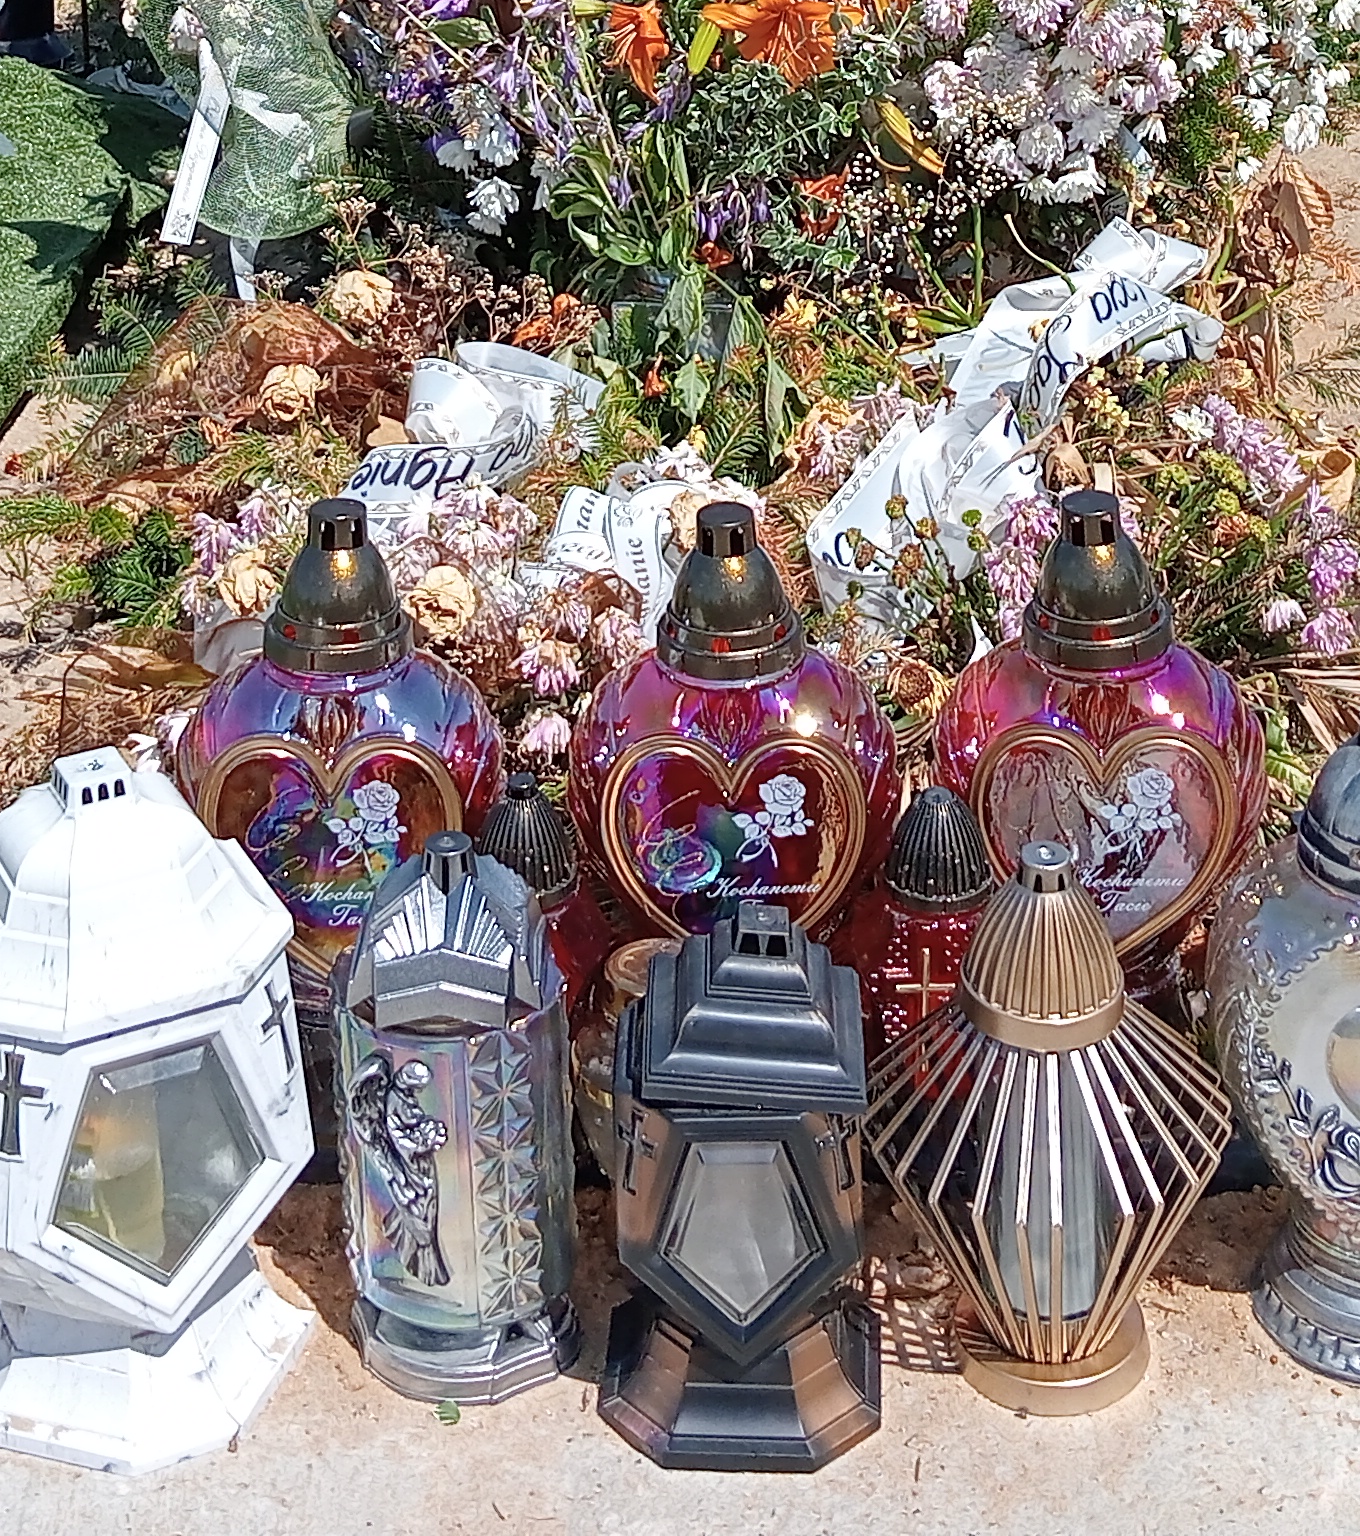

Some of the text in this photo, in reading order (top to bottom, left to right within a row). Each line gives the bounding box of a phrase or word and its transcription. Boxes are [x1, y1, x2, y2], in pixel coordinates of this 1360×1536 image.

[706, 875, 821, 899] Kochanemu
[1077, 865, 1186, 888] Kochanemu
[1097, 890, 1153, 913] Tacie
